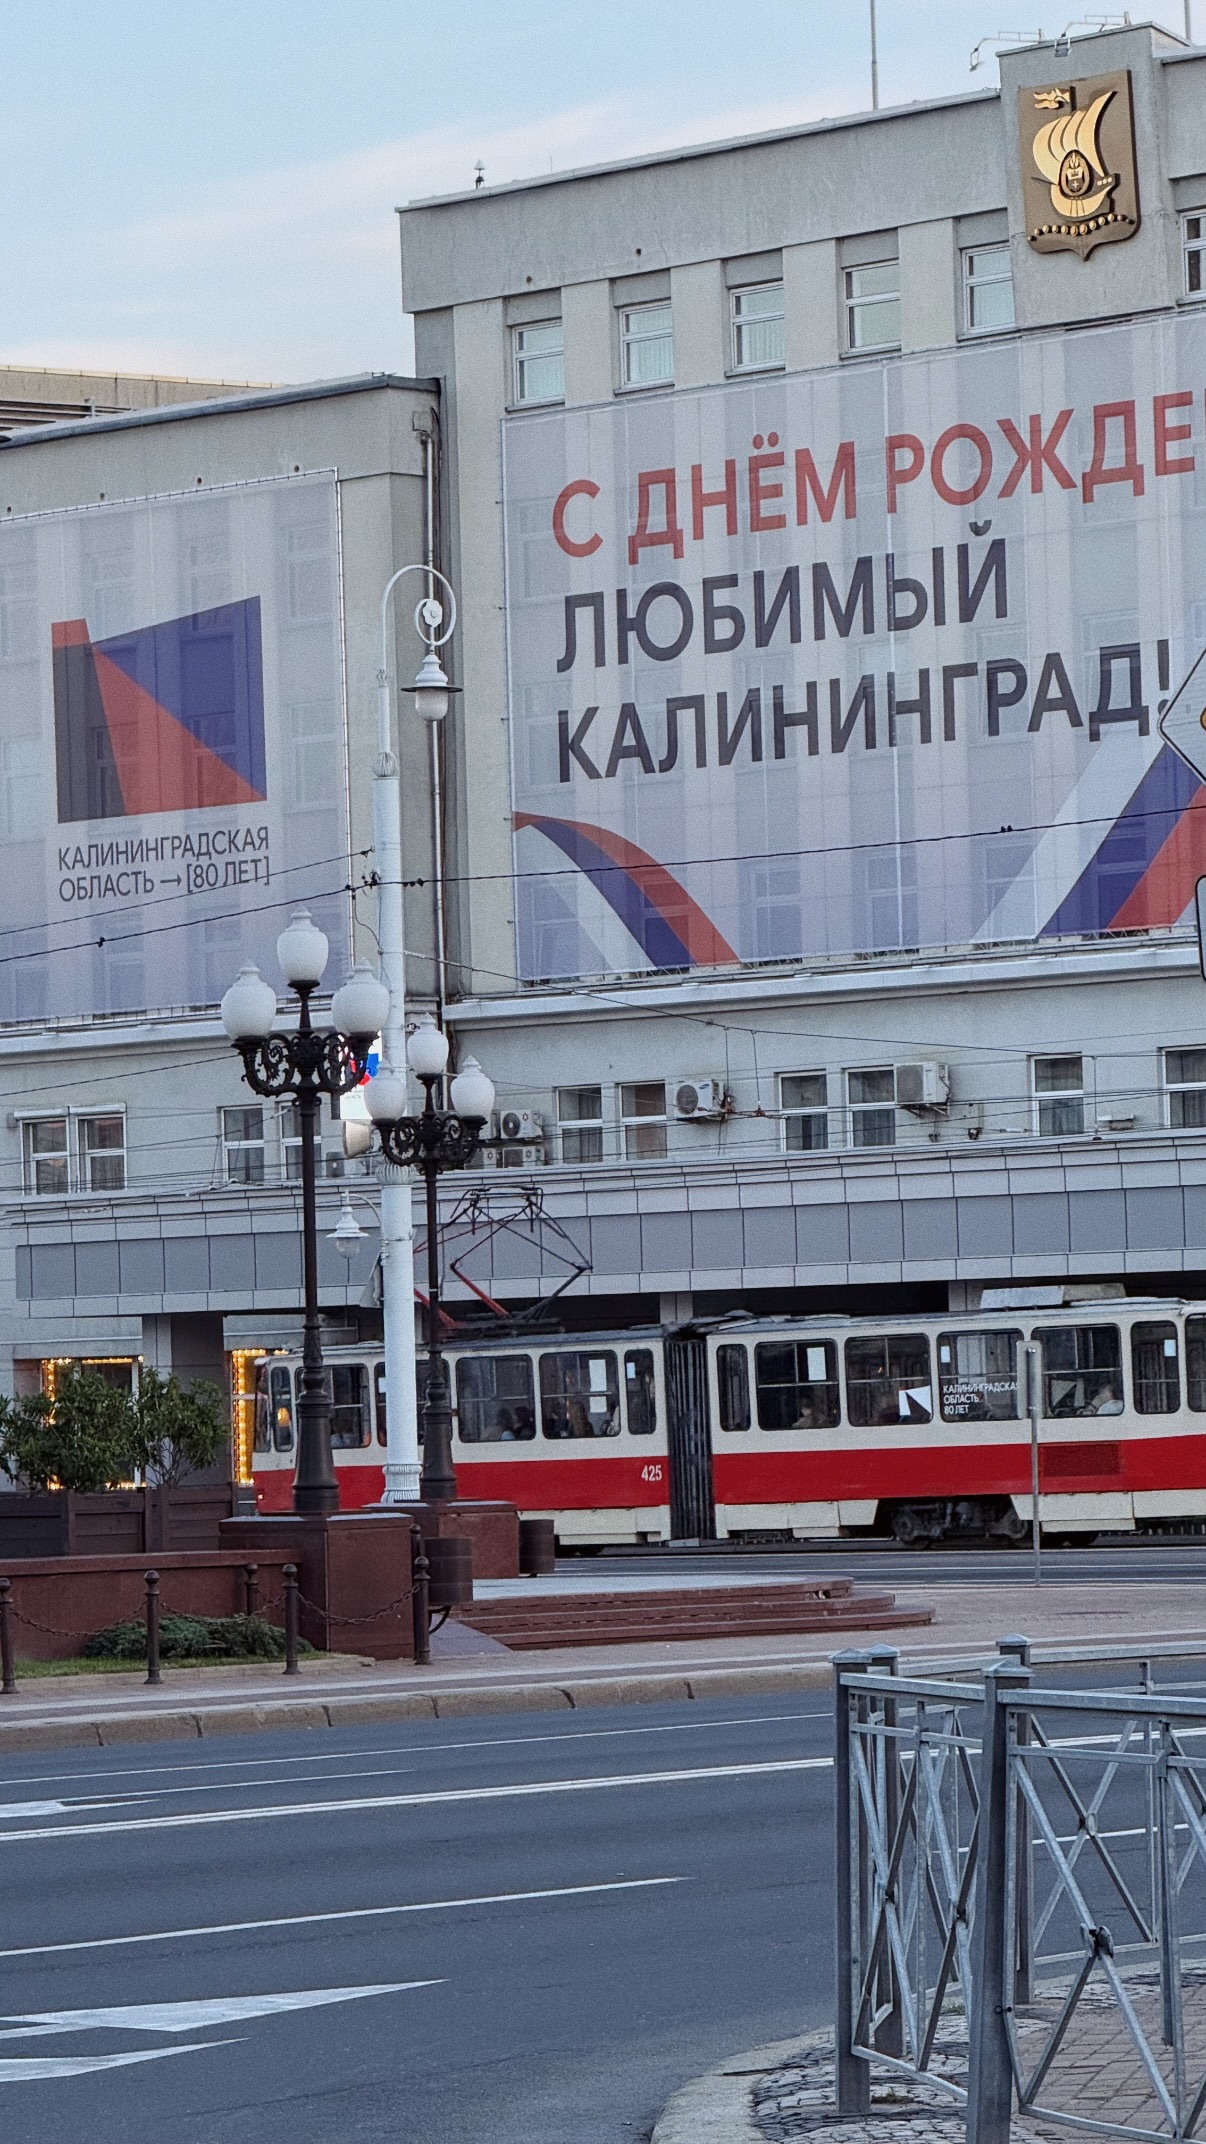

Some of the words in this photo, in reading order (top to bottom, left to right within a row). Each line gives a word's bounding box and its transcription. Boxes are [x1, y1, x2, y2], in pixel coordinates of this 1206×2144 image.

[552, 479, 604, 558] С
[628, 432, 857, 565] ДНЁМ
[885, 388, 1206, 514] РОЖДЕ
[556, 520, 1008, 674] ЛЮБИМЫЙ
[556, 638, 1170, 784] КАЛИНИНГРАД!
[58, 826, 269, 872] КАЛИНИНГРАДСКАЯ
[59, 870, 155, 902] ОБЛАСТЬ
[186, 862, 219, 894] [80
[222, 856, 270, 887] ЛЕТ]
[943, 1394, 980, 1404] ОБЛАСТЬ
[944, 1405, 955, 1414] 80
[955, 1405, 970, 1414] ЛЕТ
[641, 1464, 662, 1481] 425
